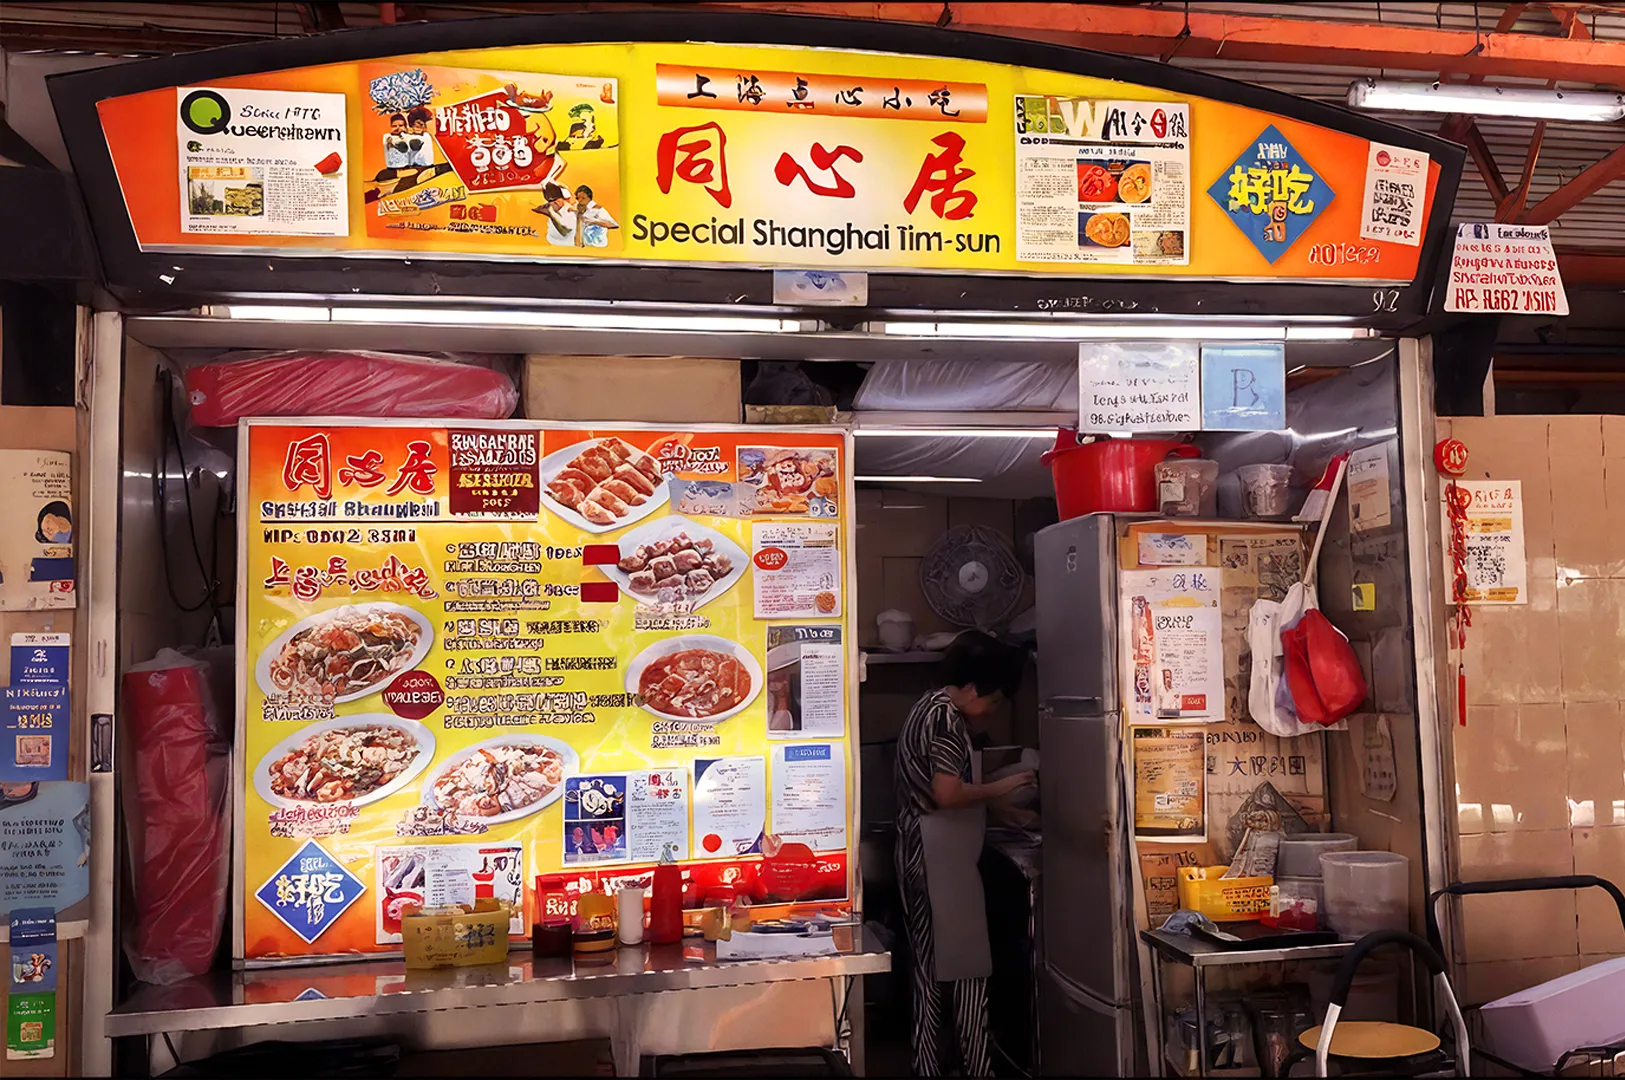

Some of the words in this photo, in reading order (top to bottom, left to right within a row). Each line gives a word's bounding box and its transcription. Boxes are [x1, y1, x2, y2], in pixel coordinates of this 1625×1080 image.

[687, 73, 961, 117] 上海点心小吃
[657, 121, 980, 221] 同心居
[632, 214, 745, 248] Special
[752, 218, 890, 255] Shanghai
